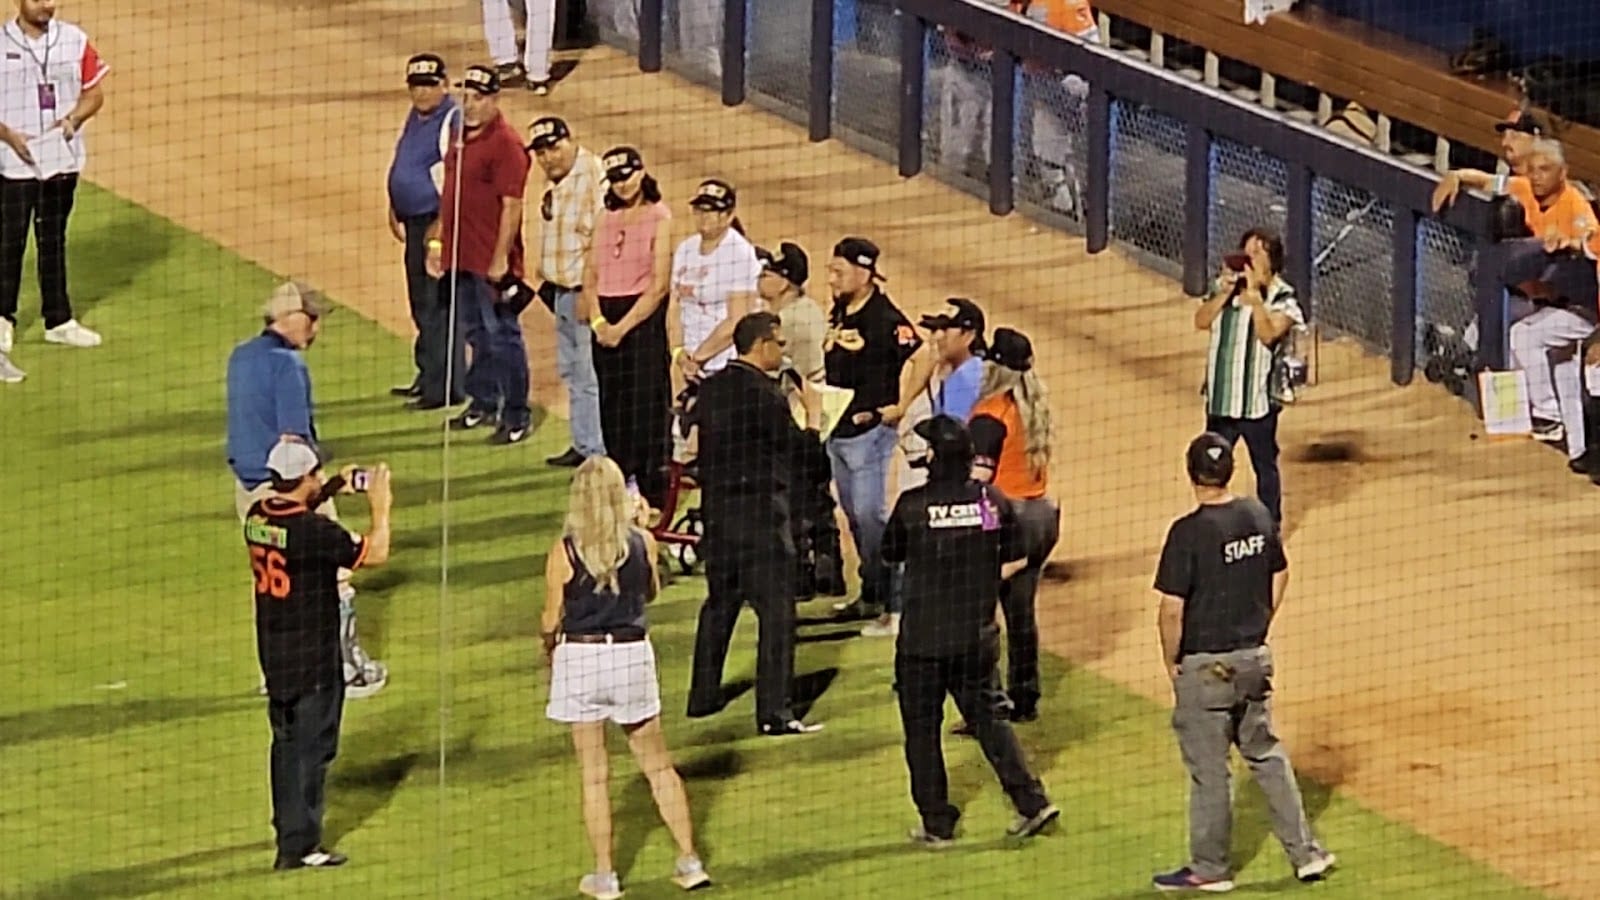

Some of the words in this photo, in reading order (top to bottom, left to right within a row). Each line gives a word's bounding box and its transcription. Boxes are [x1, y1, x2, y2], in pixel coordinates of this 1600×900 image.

[928, 505, 948, 519] TV
[1225, 535, 1265, 563] STAFF
[251, 546, 291, 598] 56
